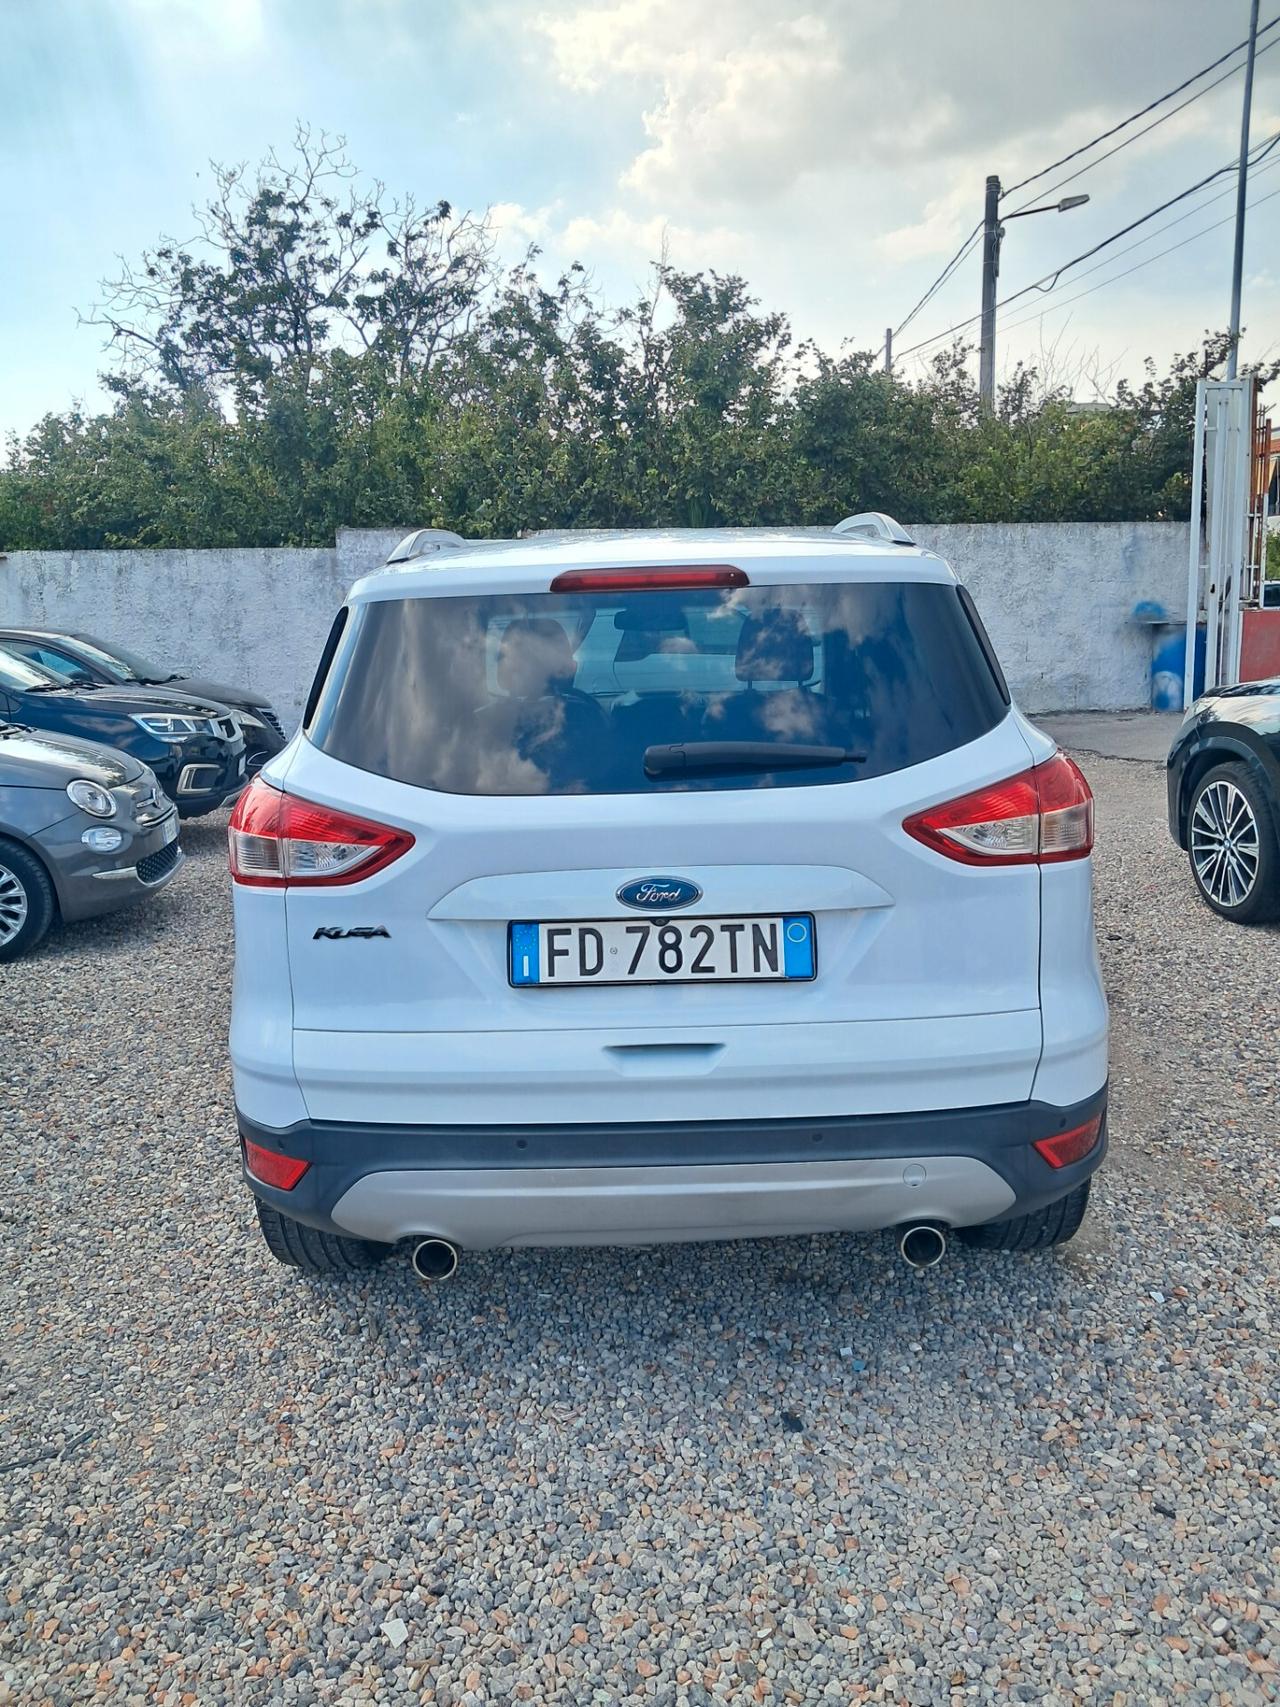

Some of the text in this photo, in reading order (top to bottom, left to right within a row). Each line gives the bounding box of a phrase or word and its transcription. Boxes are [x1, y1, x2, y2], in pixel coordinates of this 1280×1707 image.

[636, 883, 682, 902] Ford
[312, 925, 392, 940] KUGA
[547, 923, 779, 978] FD 782TN
